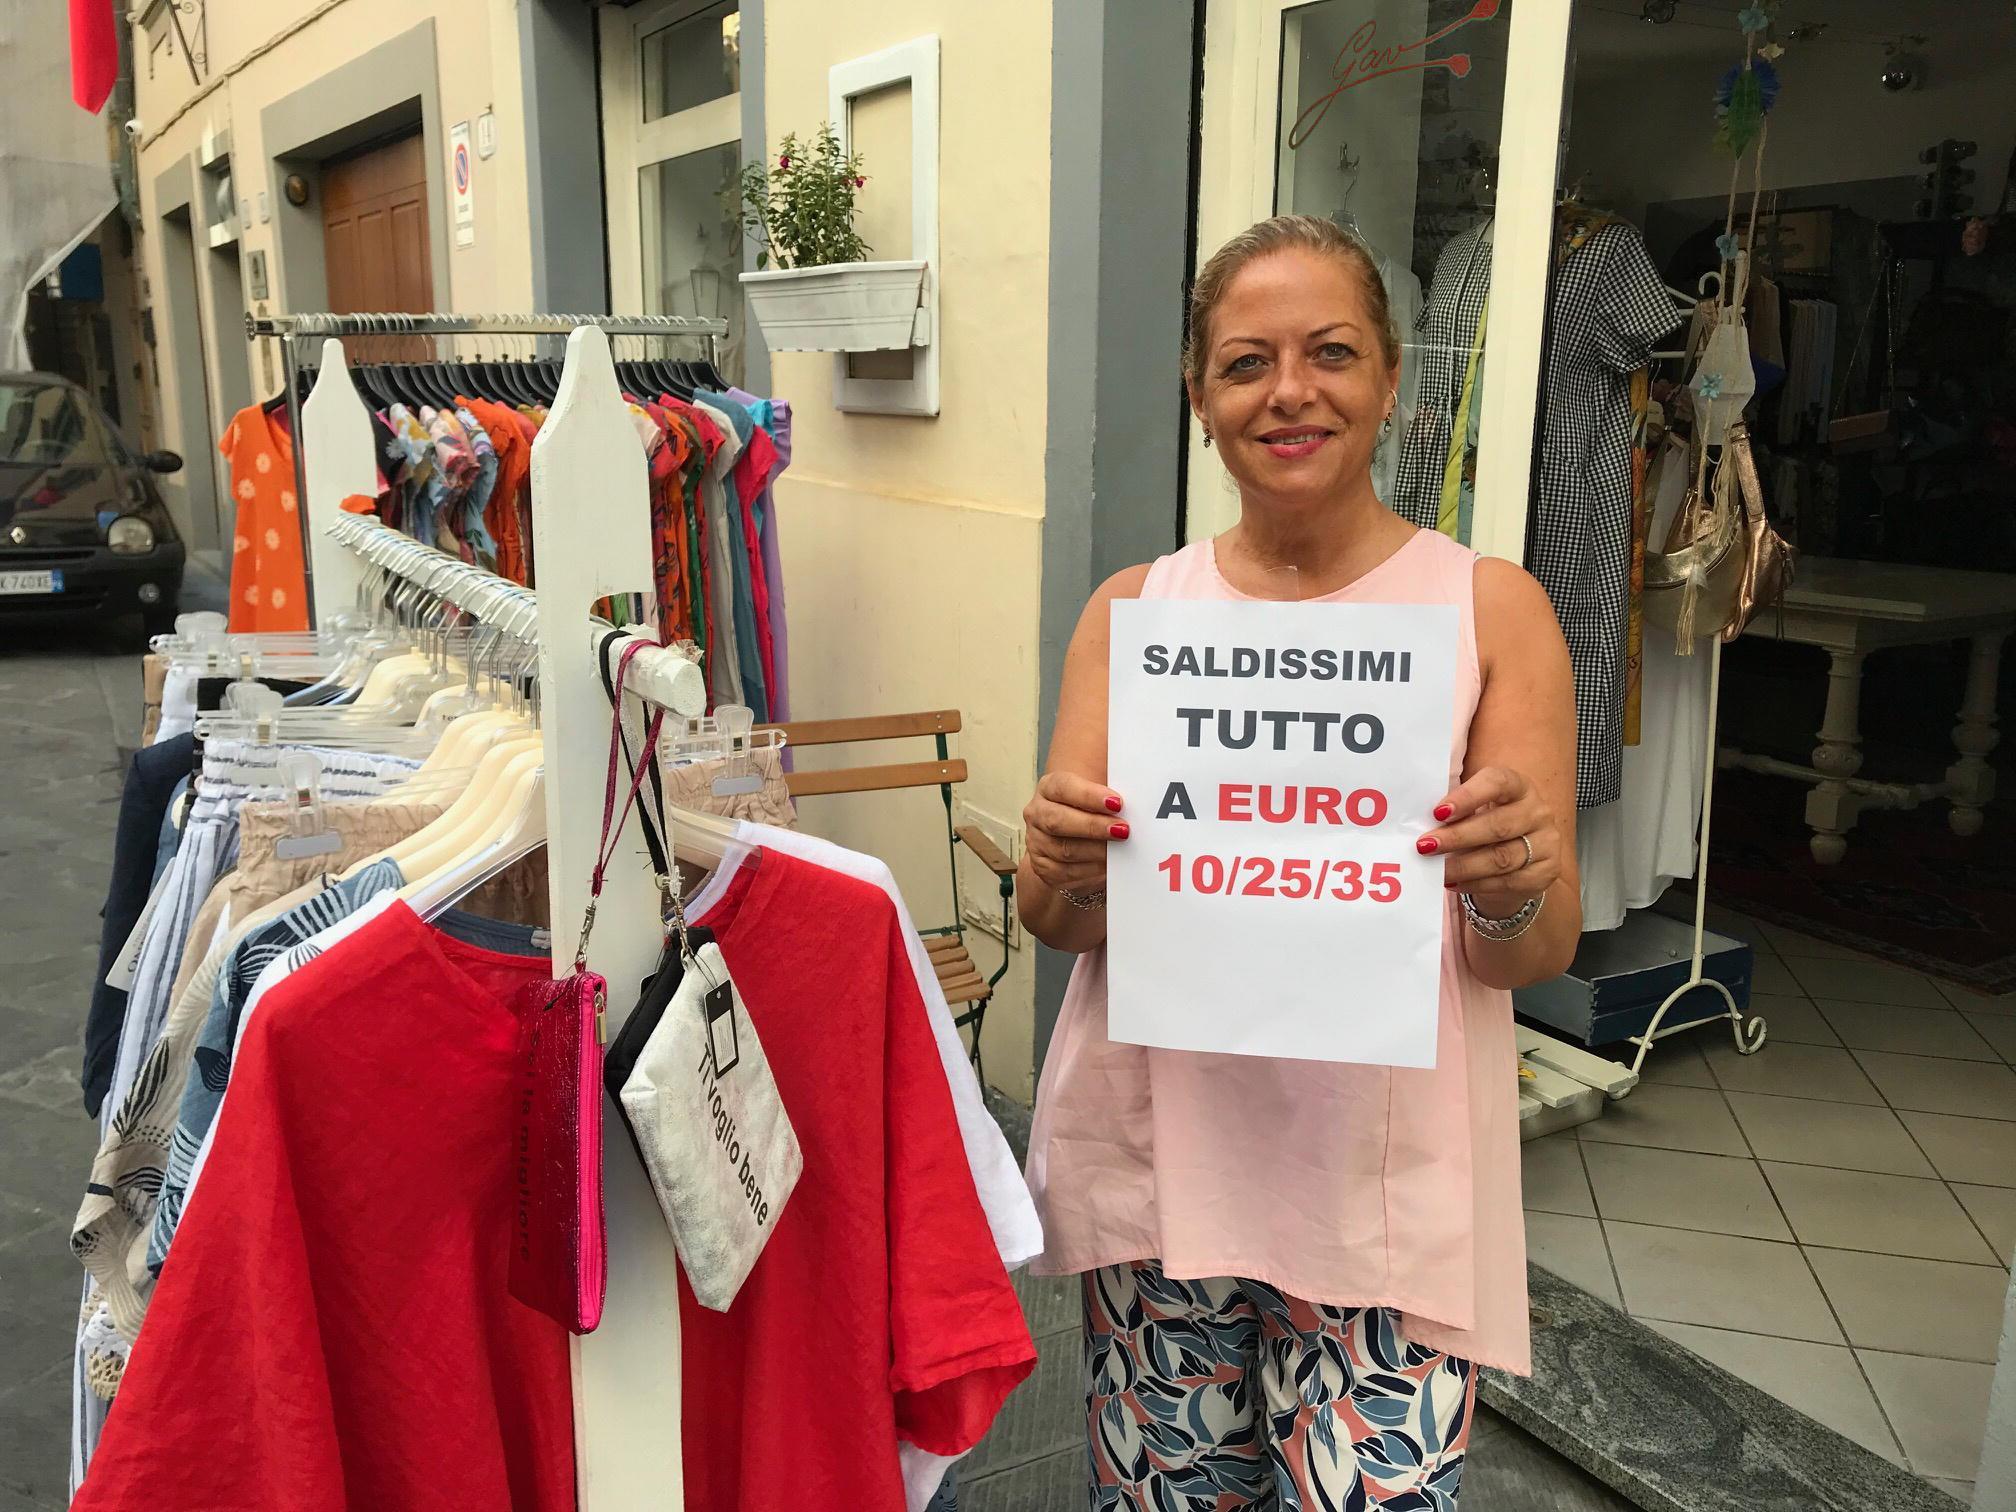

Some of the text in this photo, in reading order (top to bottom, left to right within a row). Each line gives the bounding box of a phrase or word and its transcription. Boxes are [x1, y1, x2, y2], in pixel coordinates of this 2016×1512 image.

[1142, 644, 1412, 683] SALDISSIMI
[1176, 707, 1385, 754] TUTTO
[1155, 781, 1388, 827] A EURO
[1158, 853, 1402, 904] 10/25/35
[698, 1042, 713, 1084] Ti
[707, 1083, 741, 1165] voglio
[737, 1151, 769, 1227] bene
